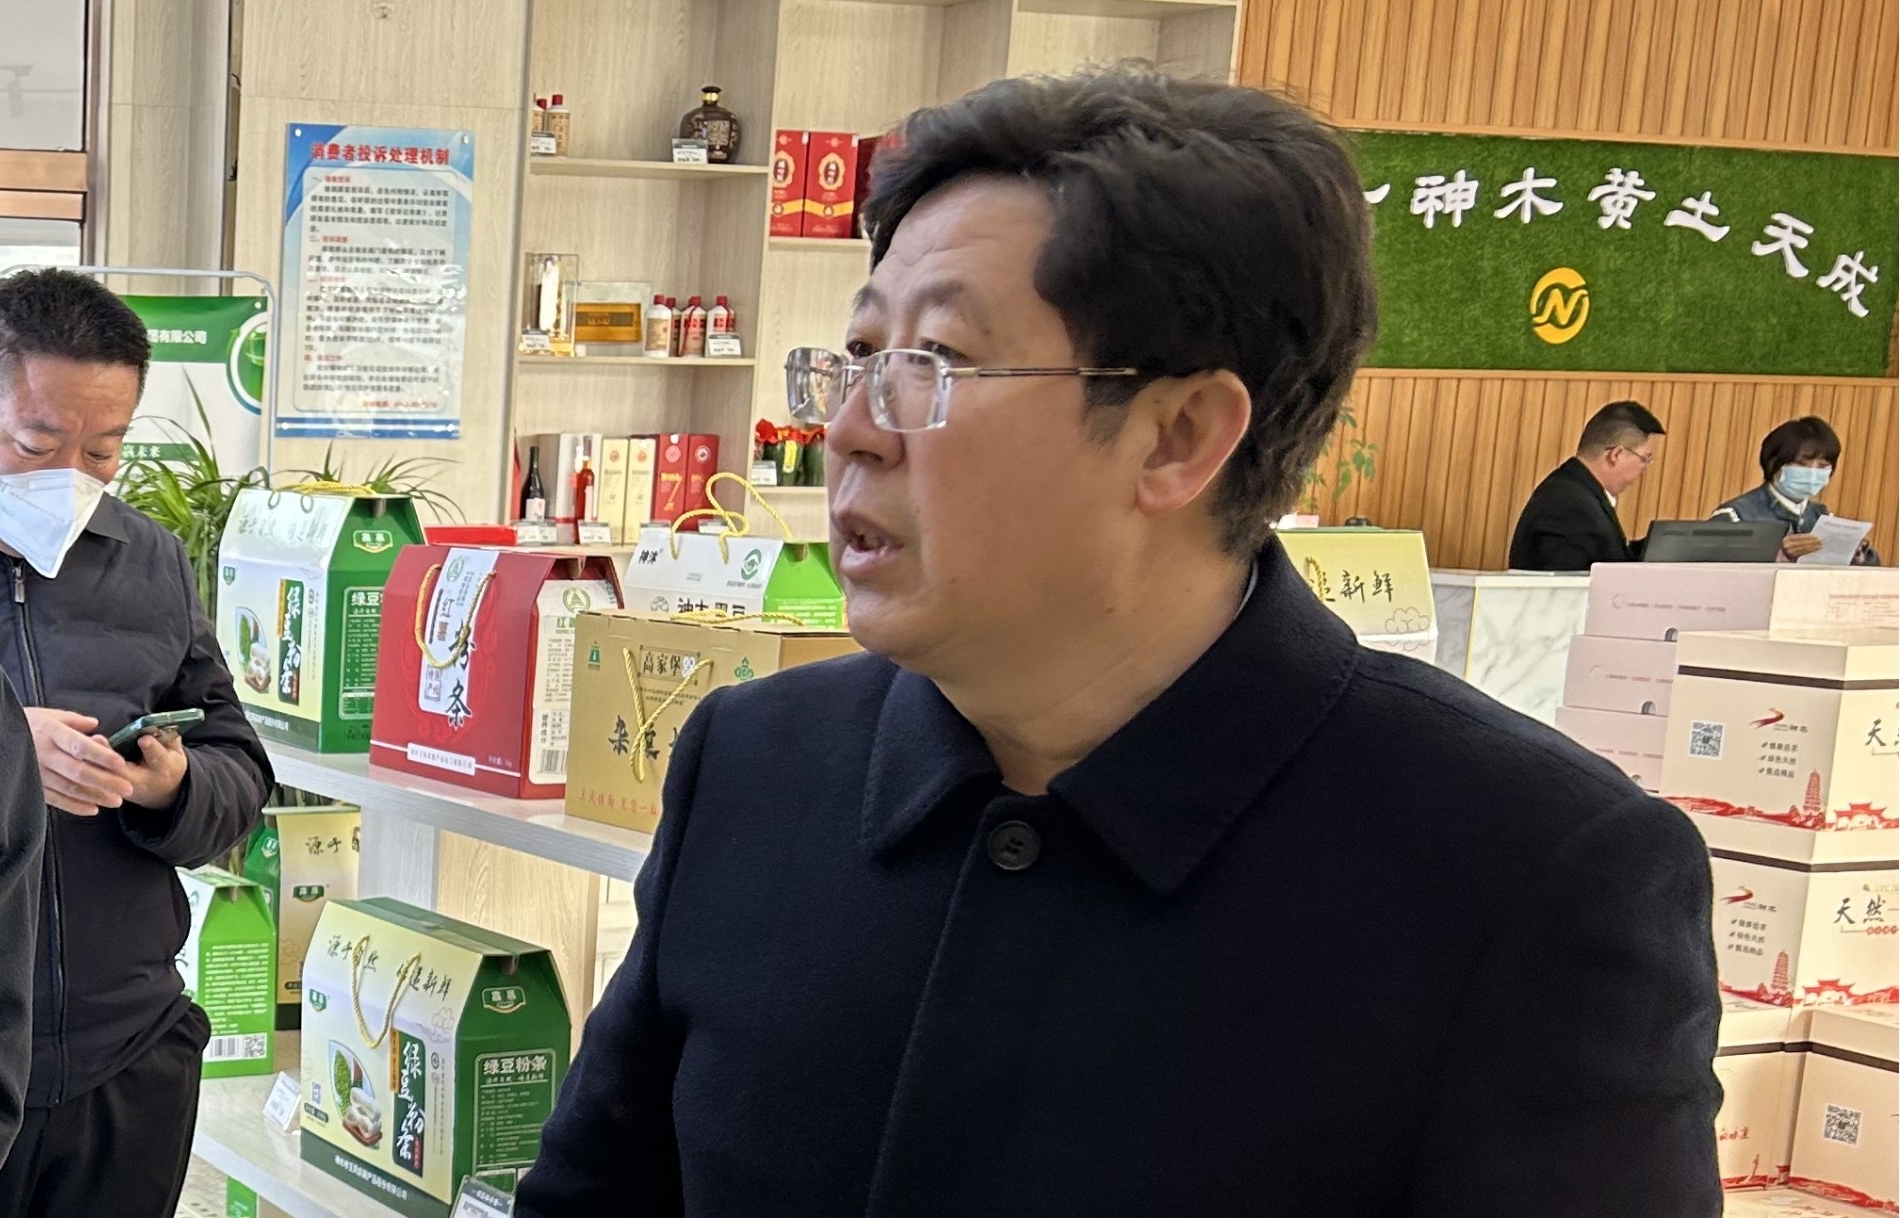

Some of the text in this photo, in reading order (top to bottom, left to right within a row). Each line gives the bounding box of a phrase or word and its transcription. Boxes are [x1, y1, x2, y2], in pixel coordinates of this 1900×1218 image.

[310, 142, 451, 166] 消费者投诉处理机制
[1364, 166, 1879, 318] 神木黄土天成
[350, 591, 385, 607] 绿豆
[483, 1055, 548, 1076] 绿豆粉条
